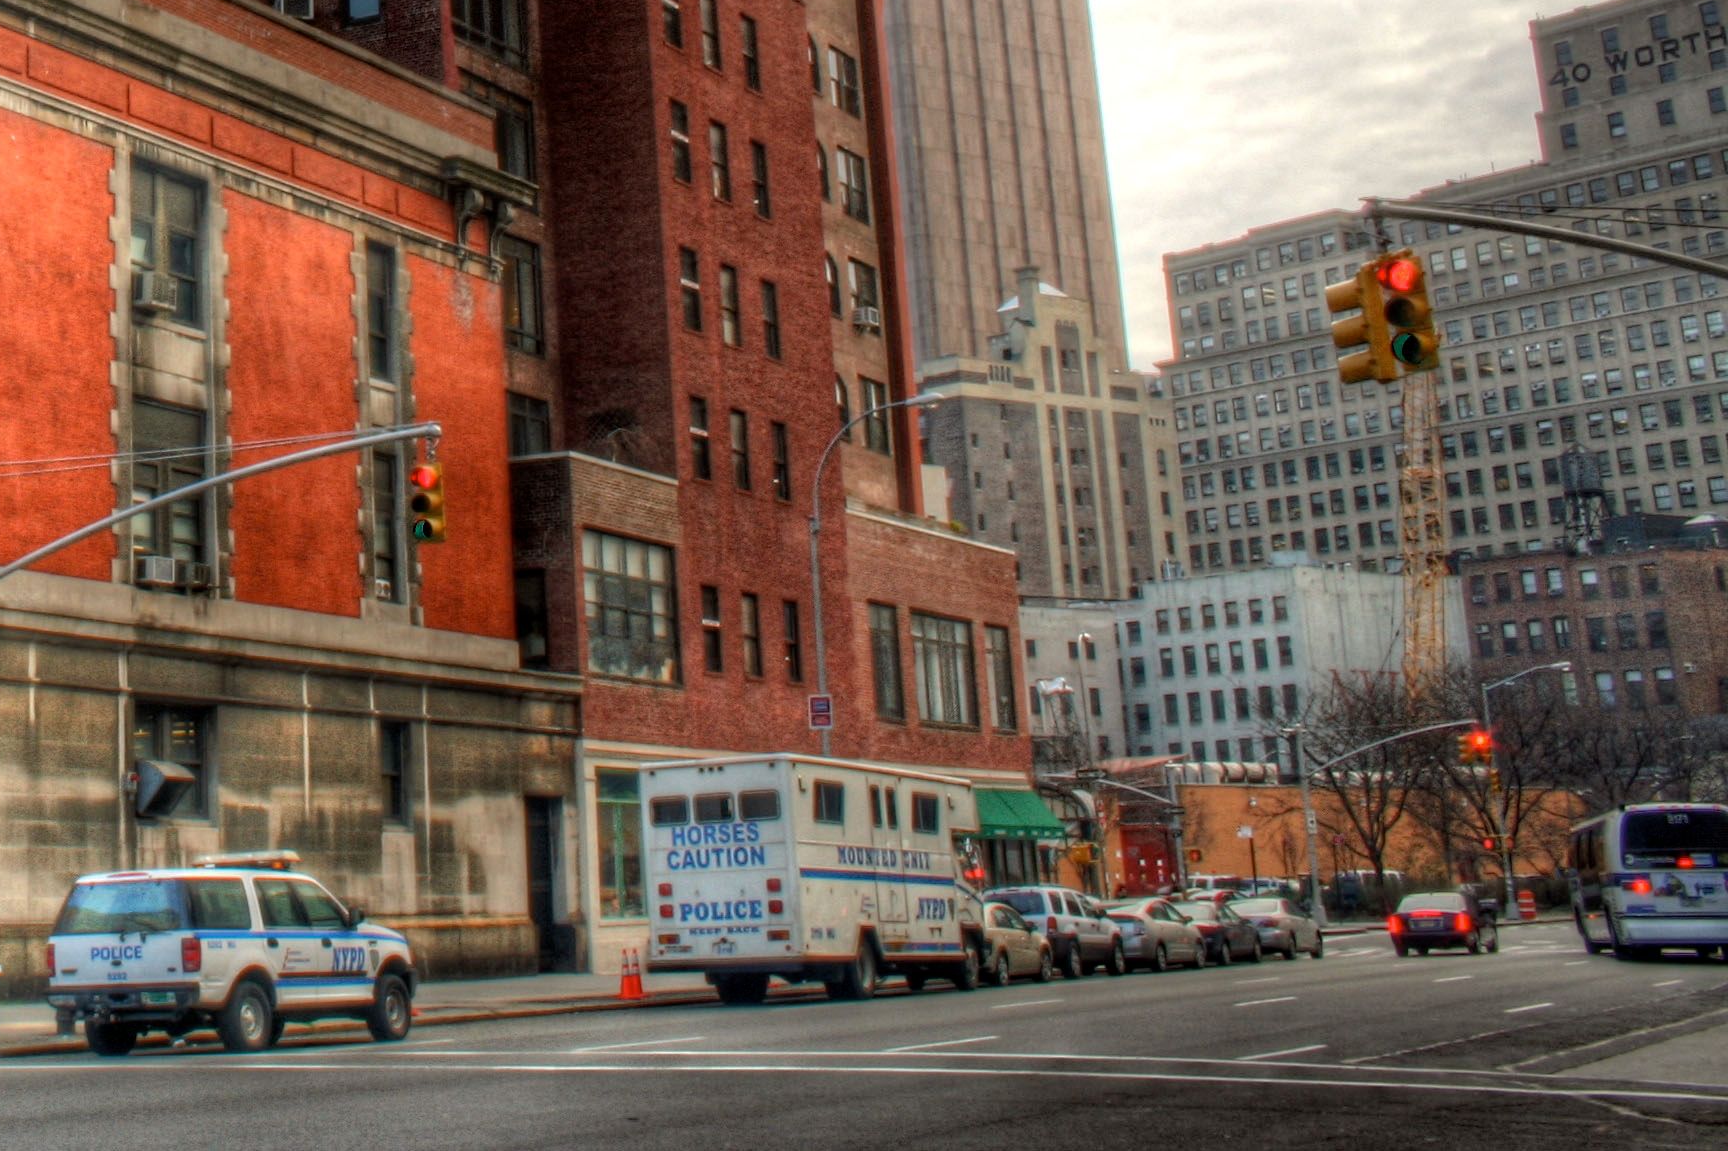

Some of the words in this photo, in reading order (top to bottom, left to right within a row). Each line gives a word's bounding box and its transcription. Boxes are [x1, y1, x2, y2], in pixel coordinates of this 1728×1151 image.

[1549, 63, 1591, 87] 40
[1605, 26, 1728, 73] WORTH
[672, 822, 760, 846] HORSES
[667, 846, 765, 869] CAUTION
[837, 846, 897, 867] MOUNTED
[902, 849, 930, 870] UNIT
[680, 900, 763, 922] POLICE
[918, 897, 946, 920] NYPD
[689, 927, 721, 935] KEEP
[727, 926, 759, 935] BACK
[91, 946, 143, 961] POLICE
[333, 947, 365, 971] NYPD
